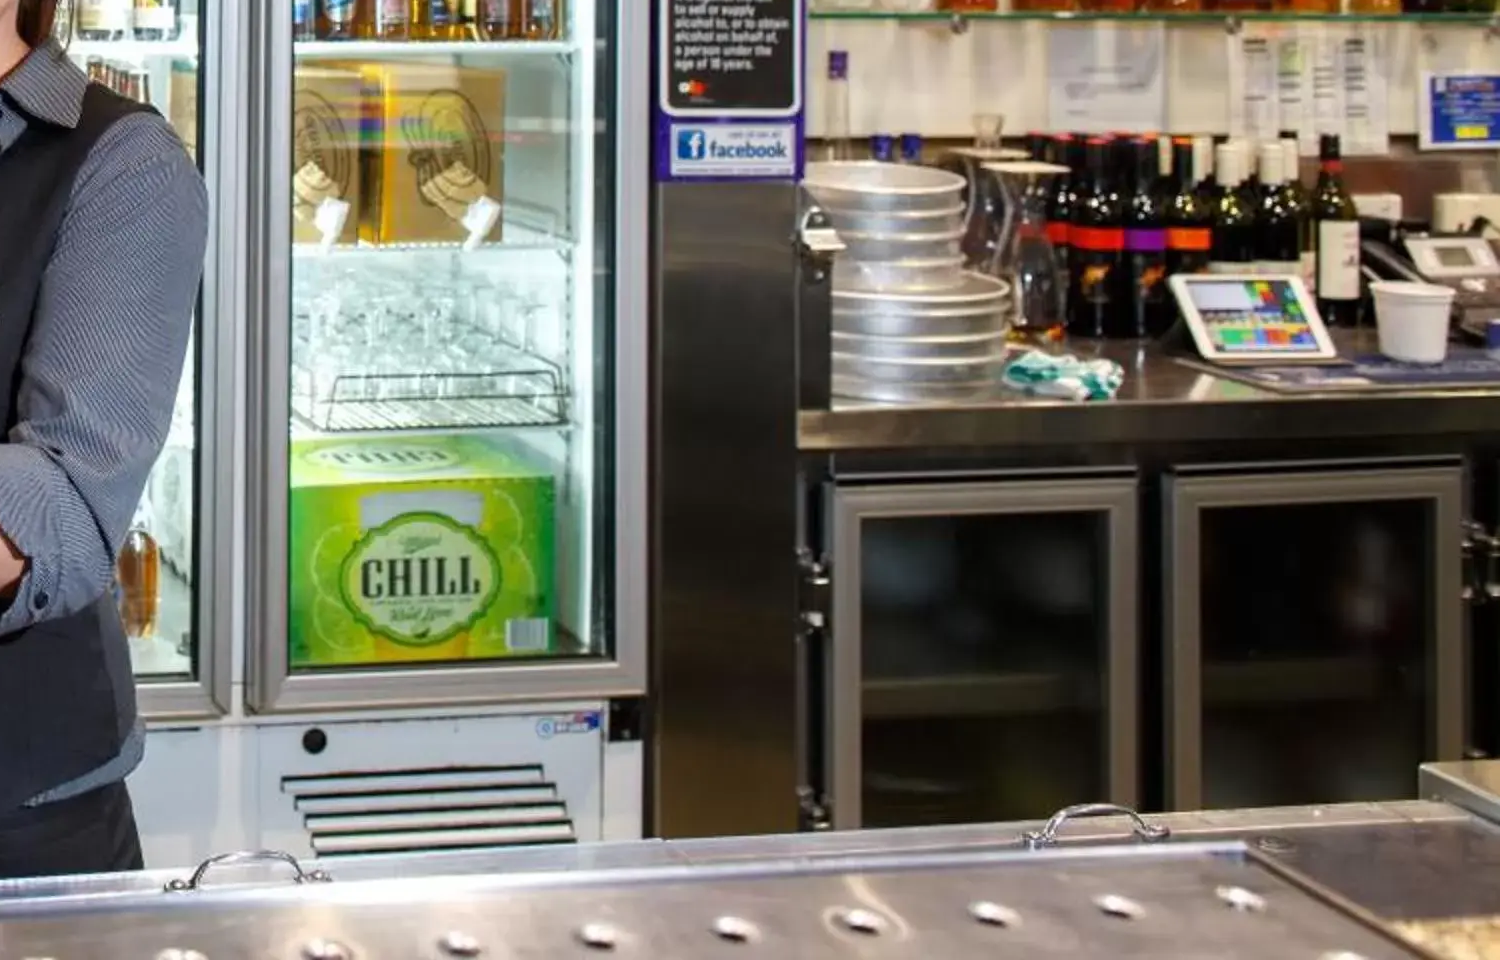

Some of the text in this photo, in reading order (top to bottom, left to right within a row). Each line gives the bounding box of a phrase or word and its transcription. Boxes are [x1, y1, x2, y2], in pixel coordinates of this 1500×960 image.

[754, 45, 772, 56] the
[709, 139, 787, 158] facebook
[361, 555, 481, 599] CHILL
